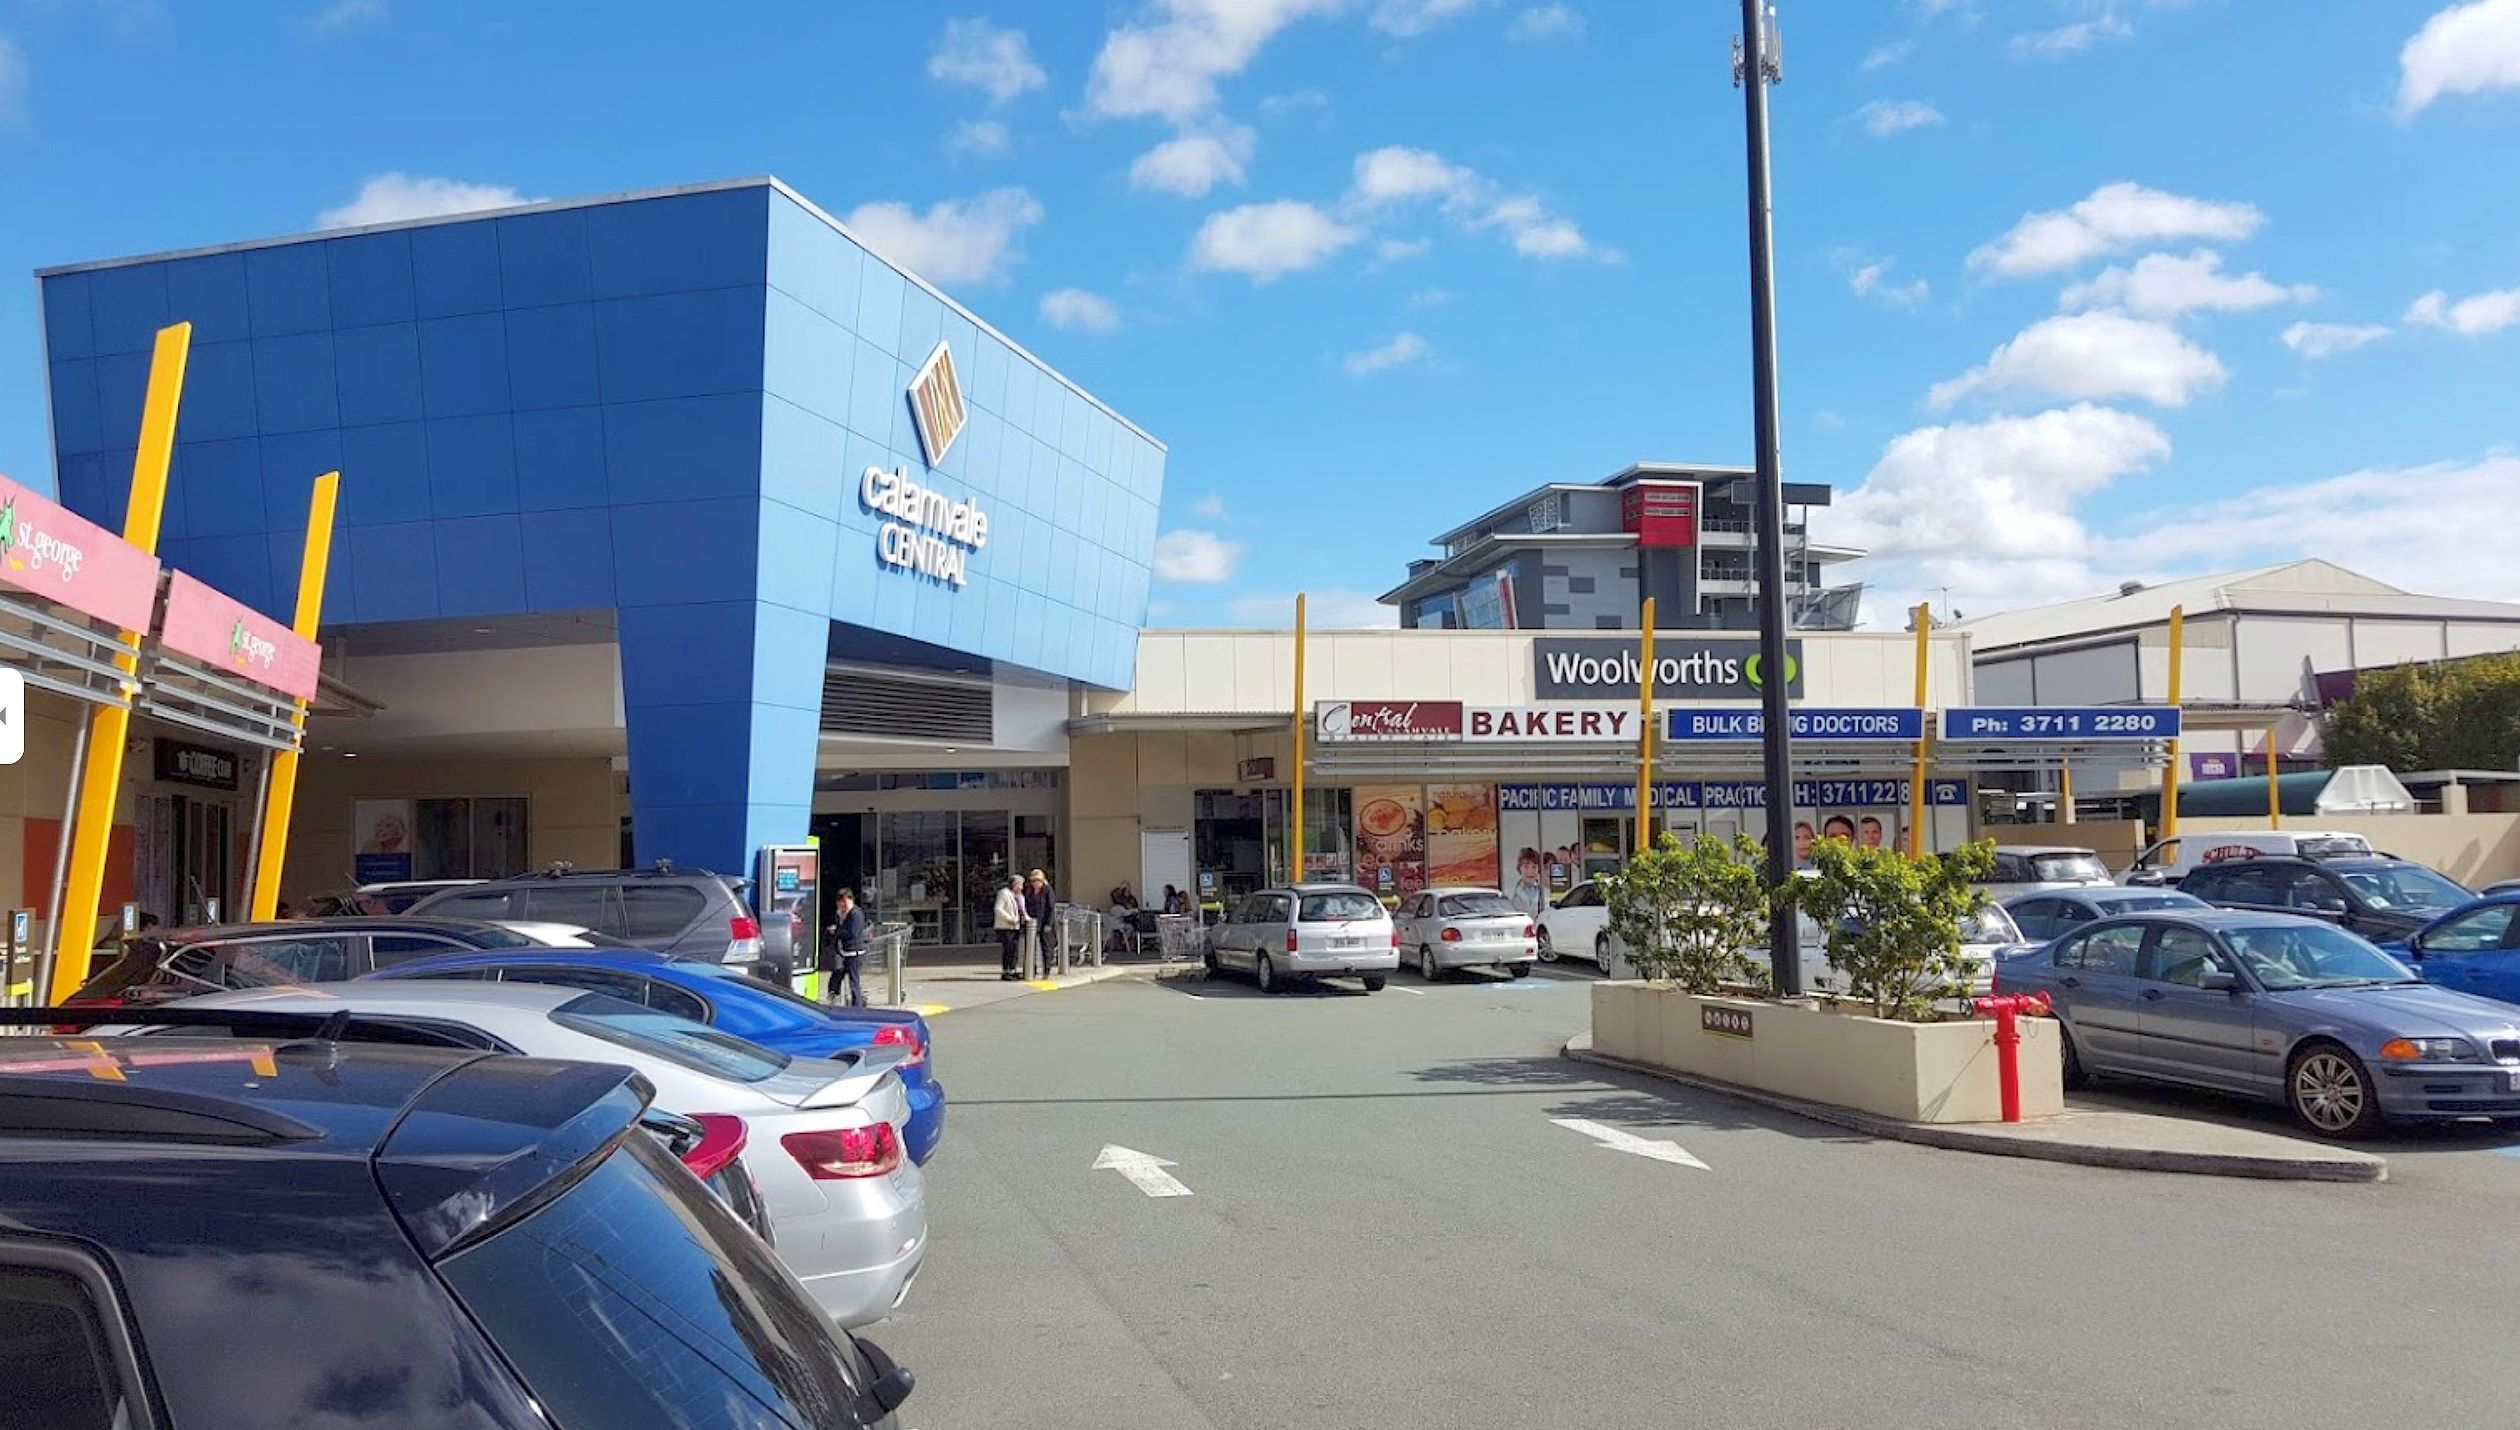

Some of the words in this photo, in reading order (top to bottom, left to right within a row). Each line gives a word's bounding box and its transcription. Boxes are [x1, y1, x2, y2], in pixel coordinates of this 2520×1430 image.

[861, 465, 988, 549] calamvale
[17, 520, 84, 583] st.george
[879, 521, 968, 587] CENTRAL
[1545, 650, 1739, 686] Woolworths
[1471, 711, 1629, 736] BAKERY
[1692, 715, 1742, 734] BULK
[1813, 715, 1899, 734] DOCTORS
[1972, 716, 2008, 733] Ph:
[2020, 715, 2080, 732] 3711
[2094, 714, 2156, 732] 2280
[1501, 788, 1557, 808] PACIFIC
[1561, 787, 1616, 807] FAMILY
[1625, 786, 1697, 806] MDICAL
[1705, 786, 1767, 806] PRACTIC
[1794, 784, 1816, 804] H:
[1823, 783, 1868, 804] 3711
[1872, 782, 1911, 802] 228
